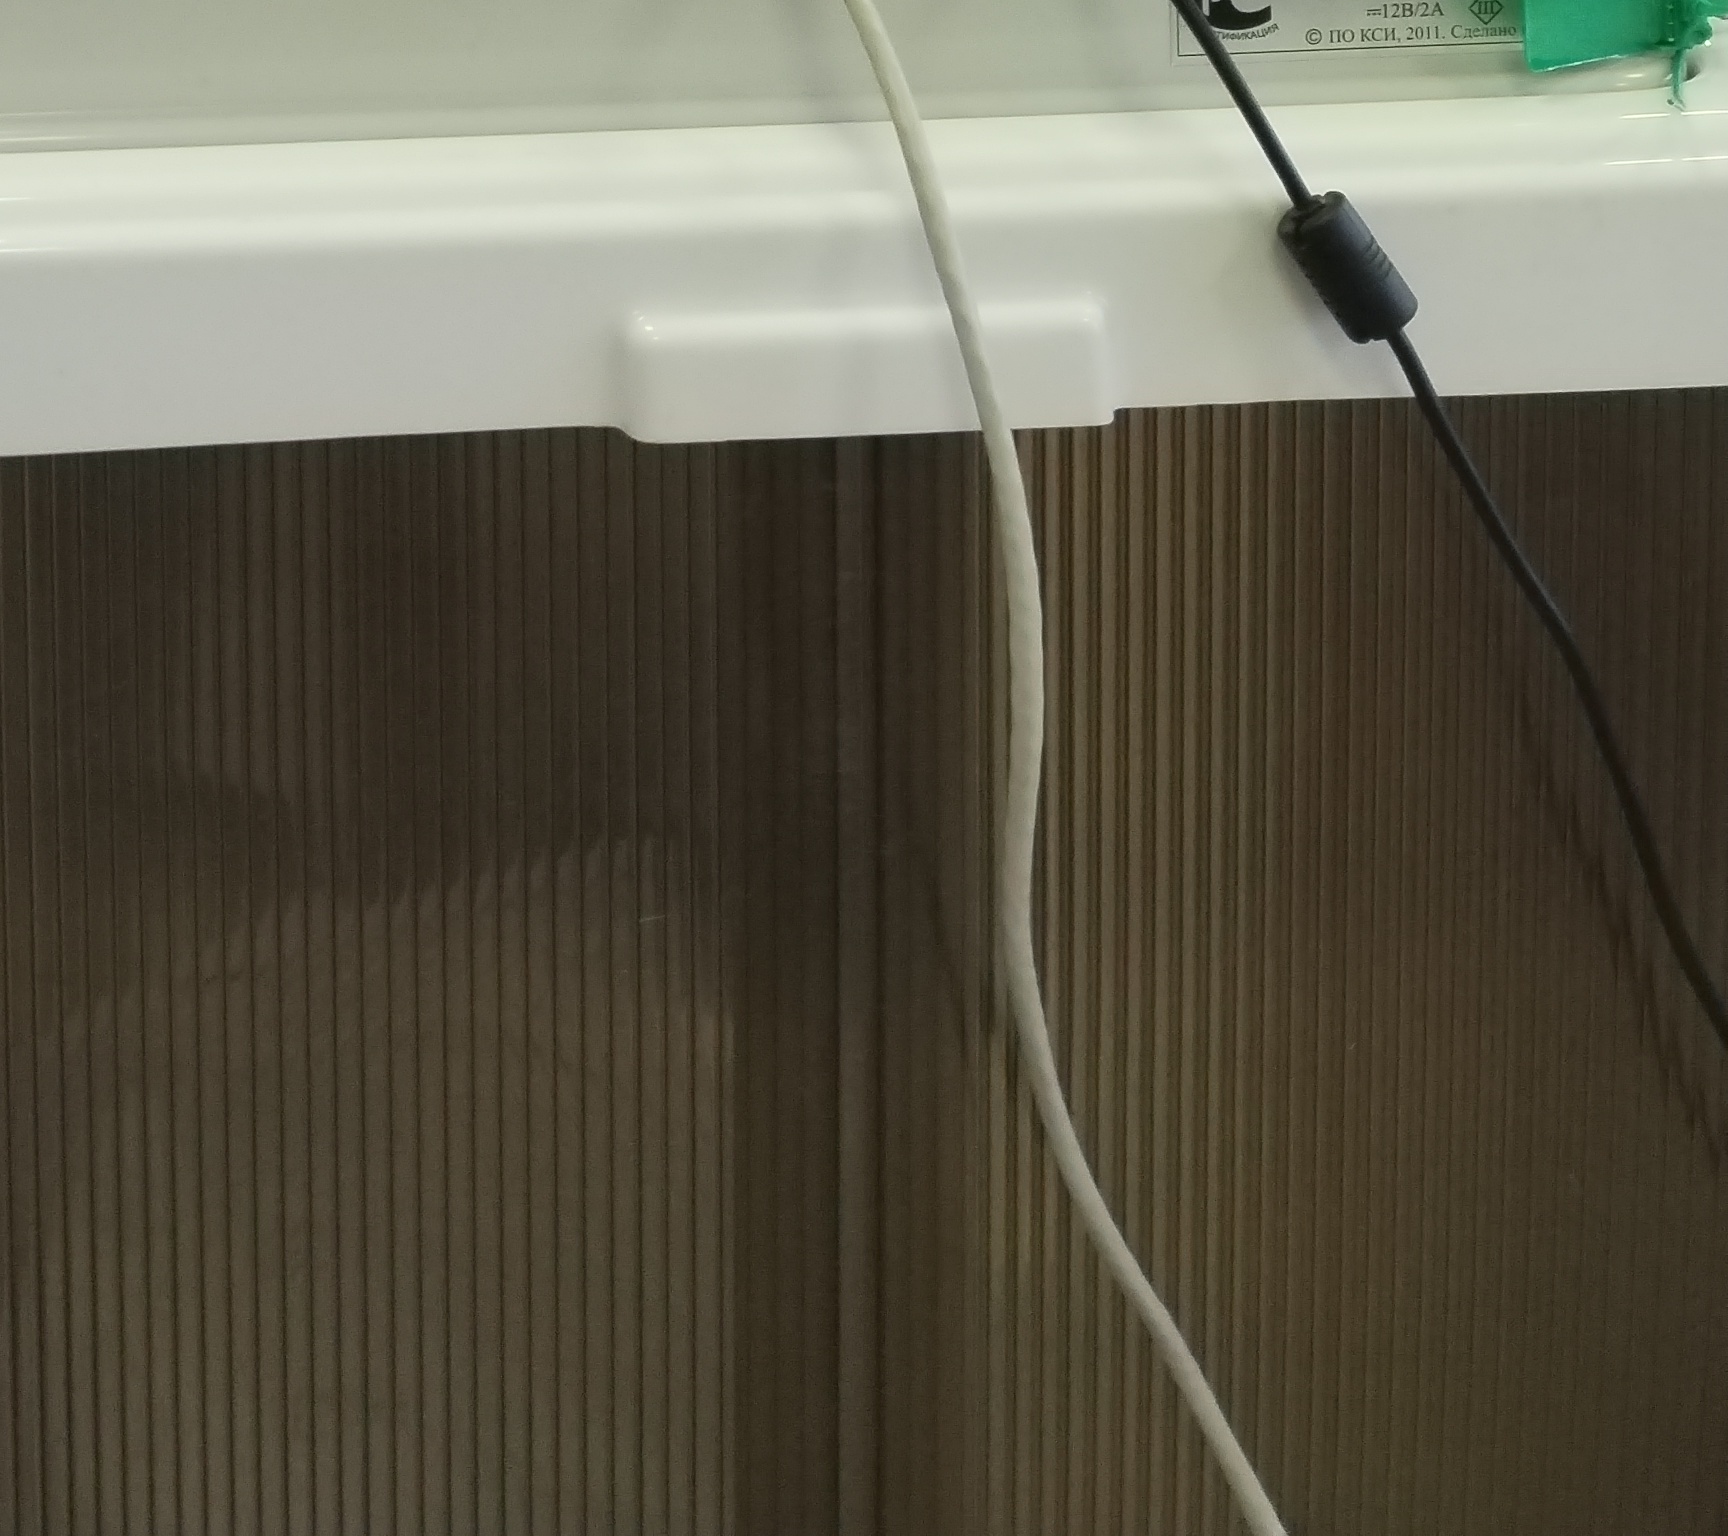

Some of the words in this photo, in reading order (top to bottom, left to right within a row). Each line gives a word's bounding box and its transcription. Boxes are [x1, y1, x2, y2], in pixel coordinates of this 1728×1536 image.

[1329, 28, 1355, 44] ПО
[1360, 27, 1402, 44] КСИ,
[1406, 25, 1446, 41] 2011.
[1450, 24, 1517, 40] Сделано
